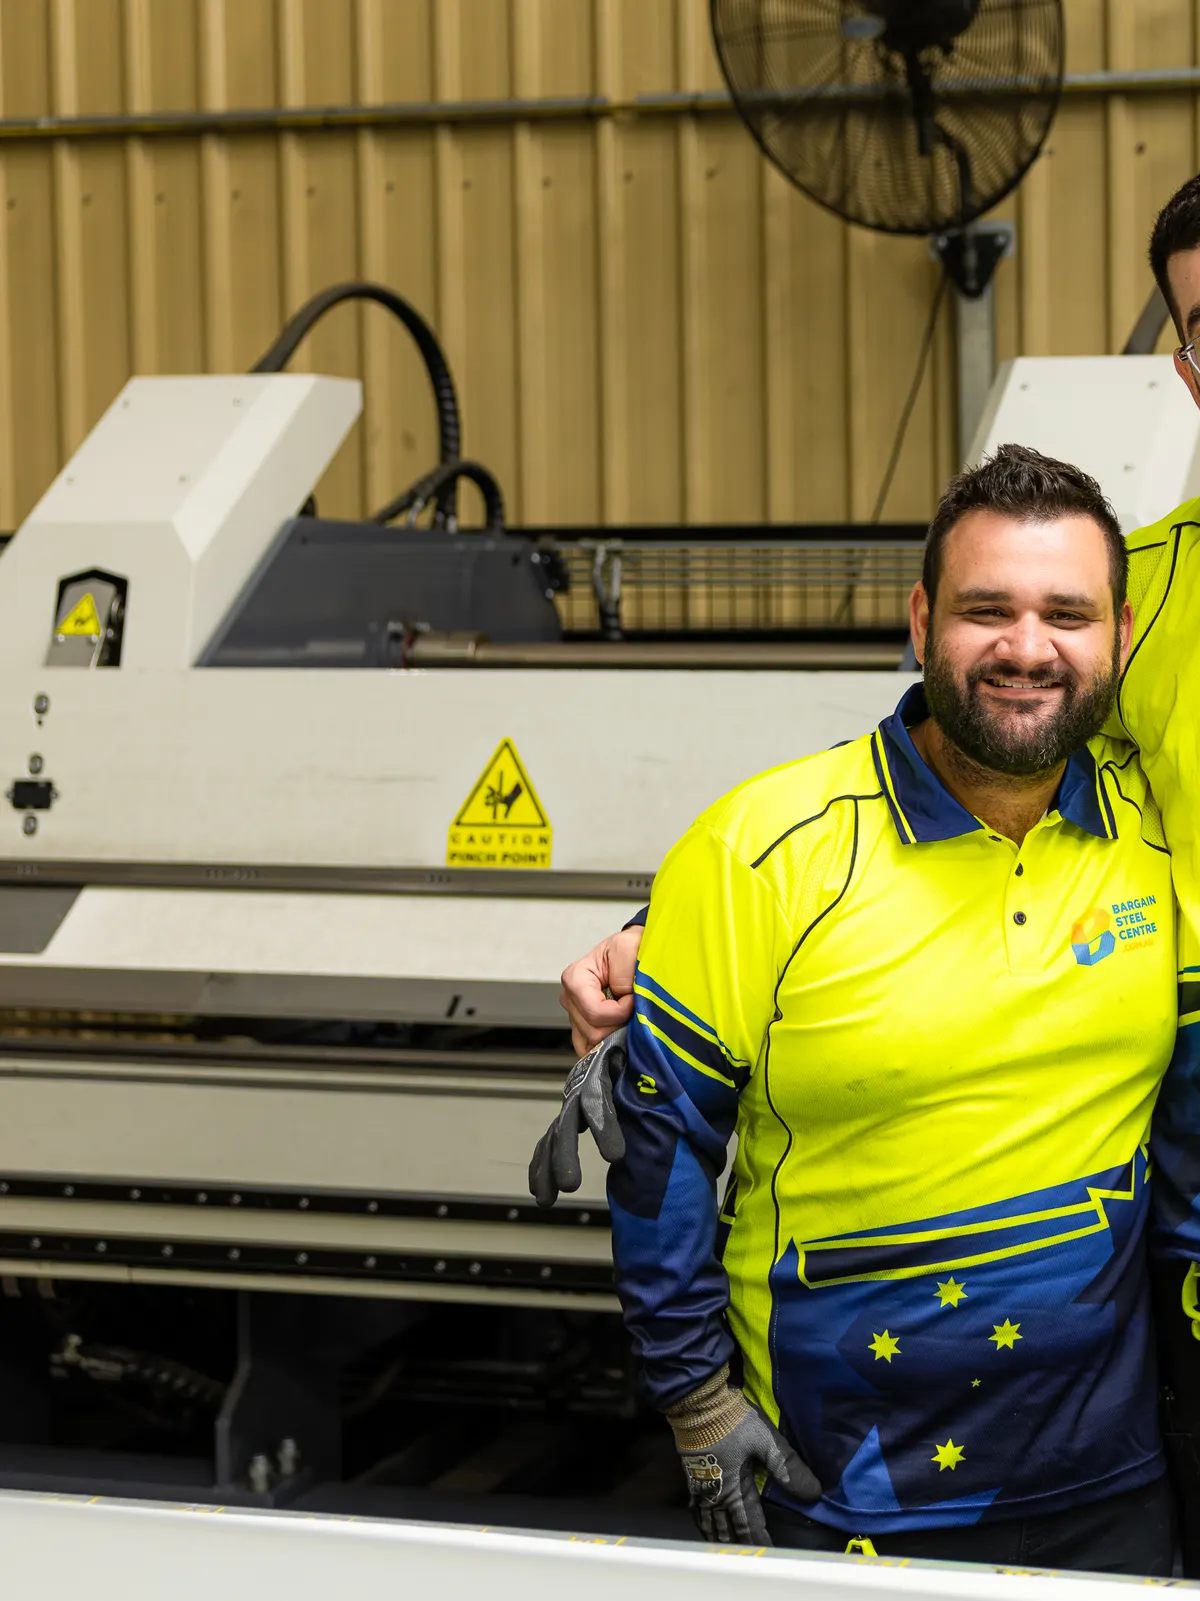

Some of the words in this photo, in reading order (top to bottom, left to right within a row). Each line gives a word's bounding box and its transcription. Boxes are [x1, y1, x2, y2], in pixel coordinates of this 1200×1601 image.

[450, 832, 549, 845] CAUTION
[449, 852, 497, 863] PINCH
[501, 852, 548, 864] POINT
[1112, 895, 1156, 914] BARGAIN
[1116, 912, 1146, 926] STEEL
[1119, 923, 1157, 940] CENTRE
